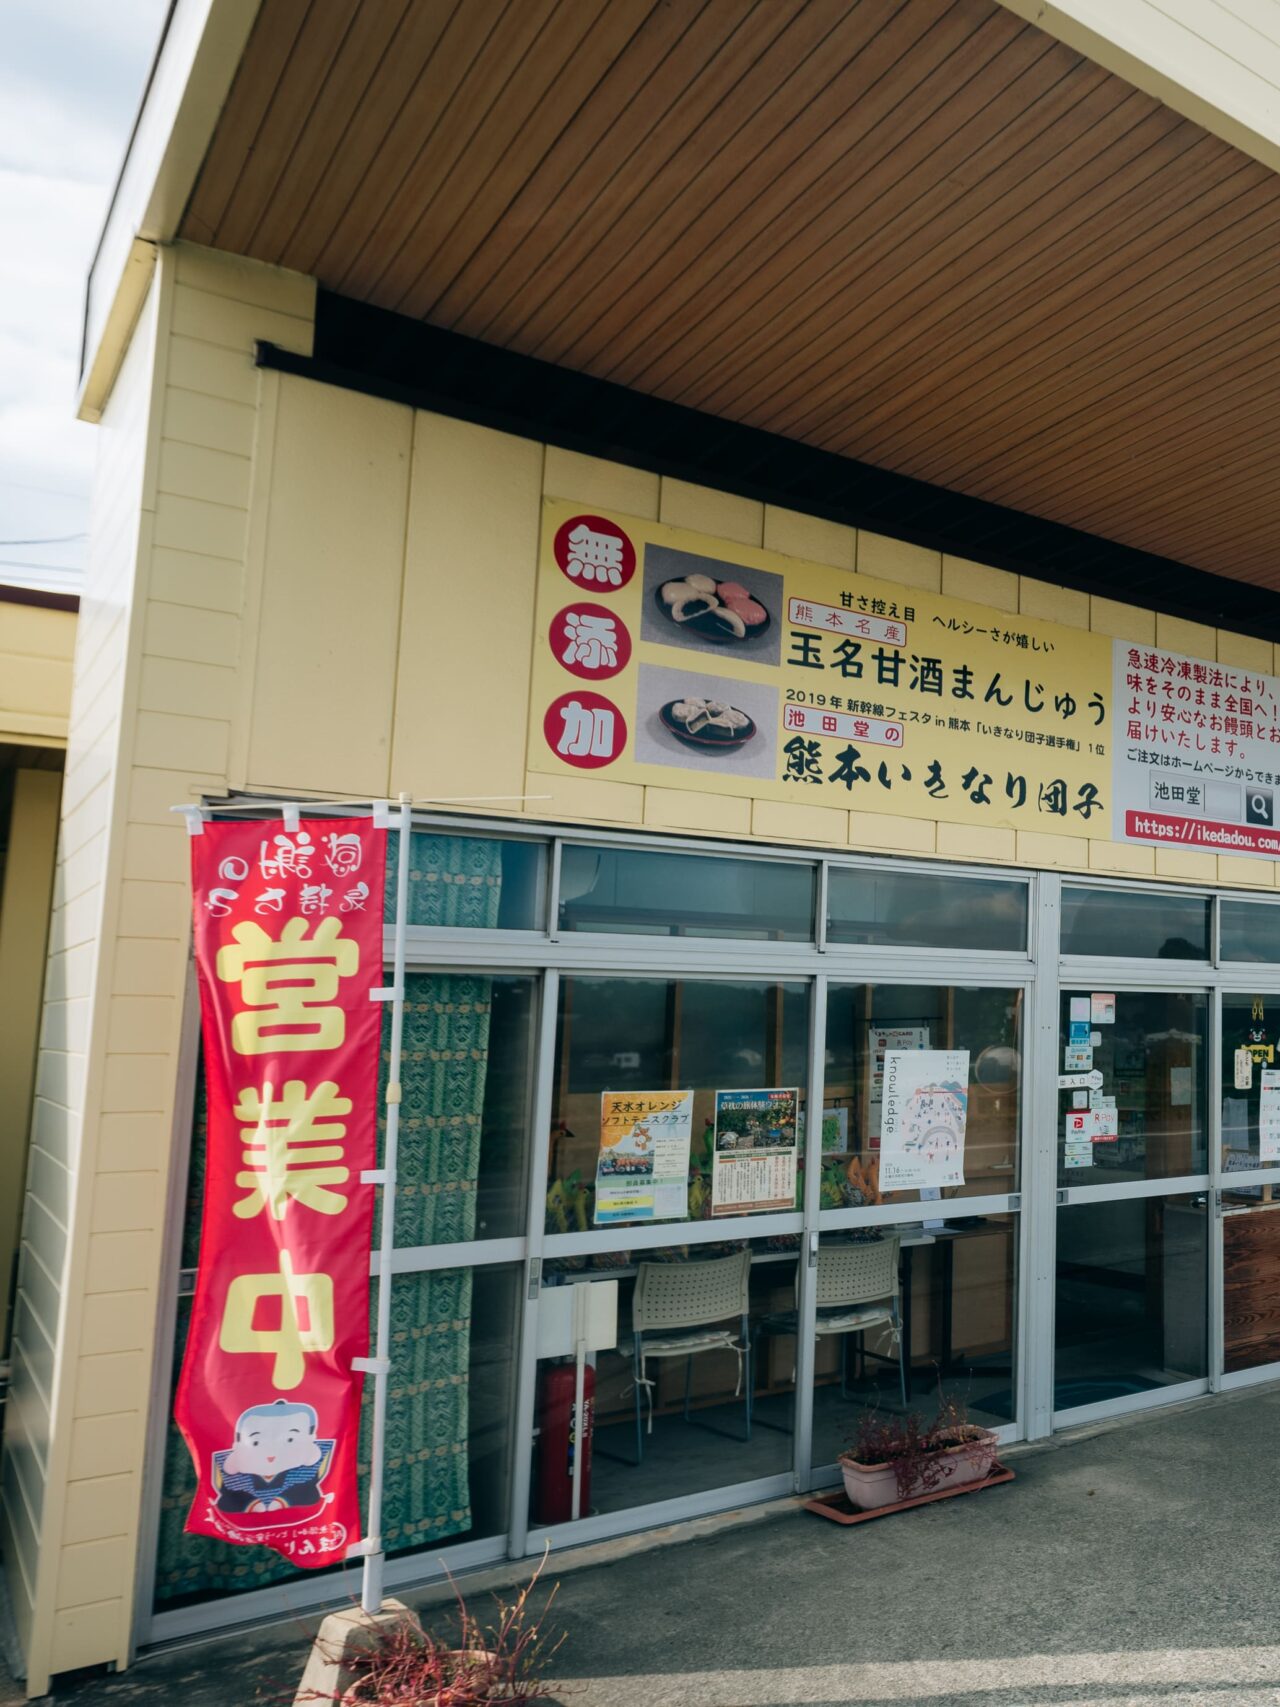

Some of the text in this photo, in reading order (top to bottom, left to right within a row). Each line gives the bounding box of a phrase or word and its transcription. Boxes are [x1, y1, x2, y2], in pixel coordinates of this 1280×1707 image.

[556, 523, 624, 759] 無添加
[794, 602, 902, 641] 熊本名産
[840, 591, 1055, 652] 甘さ控え目 ヘルシーさが嬉しい
[786, 630, 1106, 725] 玉名甘酒まんじゅう
[788, 709, 899, 741] 池田堂の
[847, 699, 931, 724] 新幹線フェスタ
[935, 715, 945, 727] in
[1127, 720, 1246, 760] 届けいたします。
[783, 735, 1104, 819] 熊本いきなり団子
[1154, 782, 1201, 806] 池田堂
[612, 1100, 682, 1112] 天水オレンジ
[884, 1057, 901, 1134] knowledge
[602, 1113, 689, 1125] ソフトテニスクラブ
